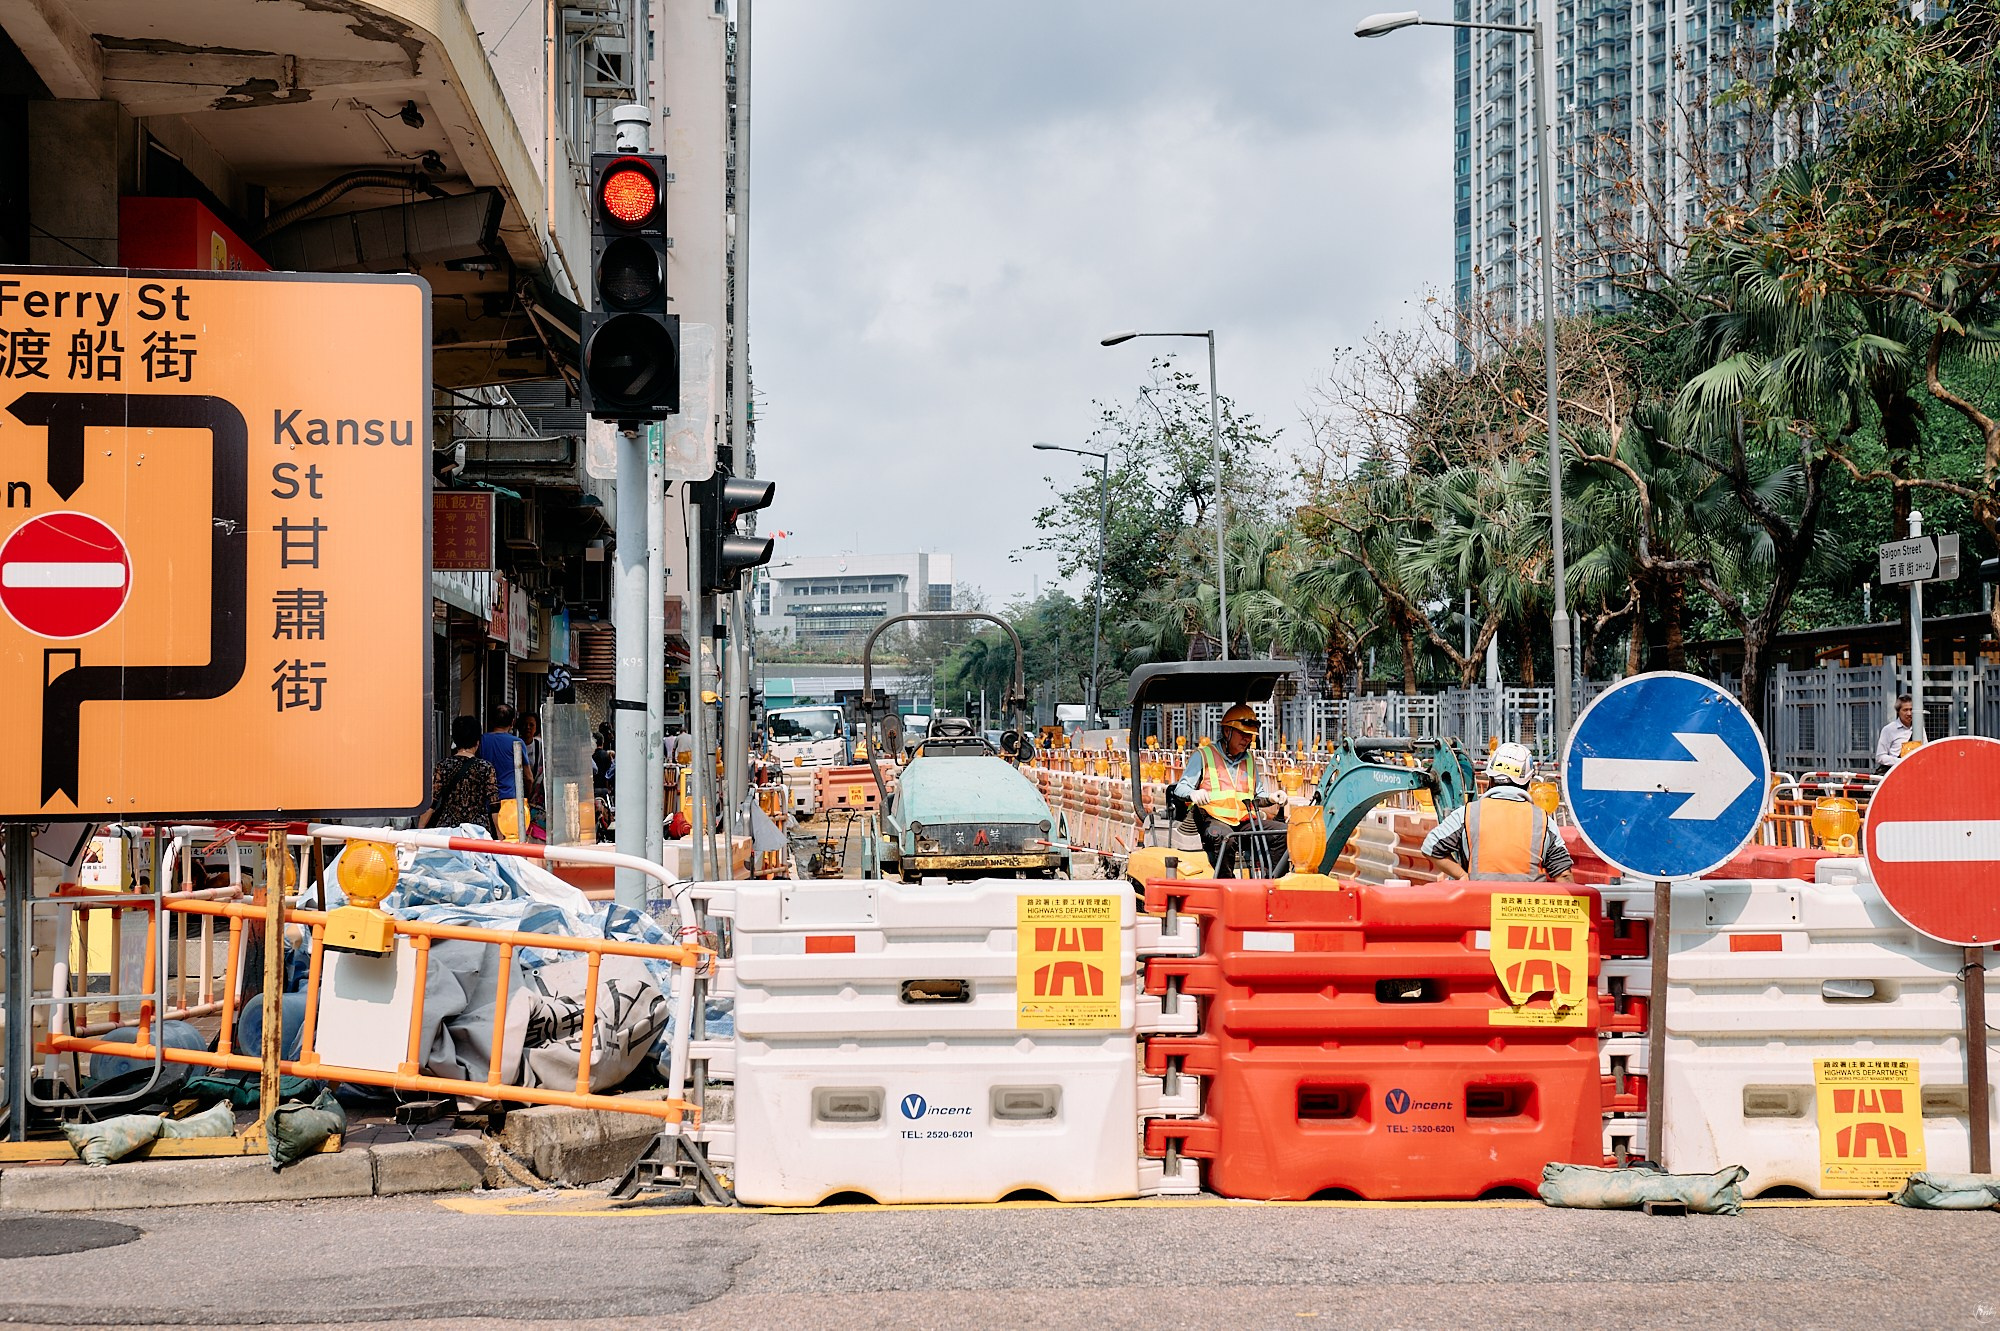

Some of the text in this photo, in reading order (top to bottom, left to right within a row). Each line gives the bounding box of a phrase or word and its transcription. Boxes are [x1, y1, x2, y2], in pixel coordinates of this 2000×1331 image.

[0, 281, 190, 326] Ferry St
[0, 328, 197, 382] 渡船街
[274, 409, 412, 446] Kansu
[271, 462, 323, 499] St
[1881, 543, 1922, 560] Saigon Street
[272, 517, 328, 712] 甘肅街
[622, 657, 643, 667] K95
[1373, 770, 1401, 784] Kubota
[901, 1093, 972, 1120] Vincent
[1385, 1089, 1453, 1114] Vincent
[901, 1131, 973, 1139] TEL: 2520-6201
[1387, 1125, 1455, 1133] TEL: 2520-6201
